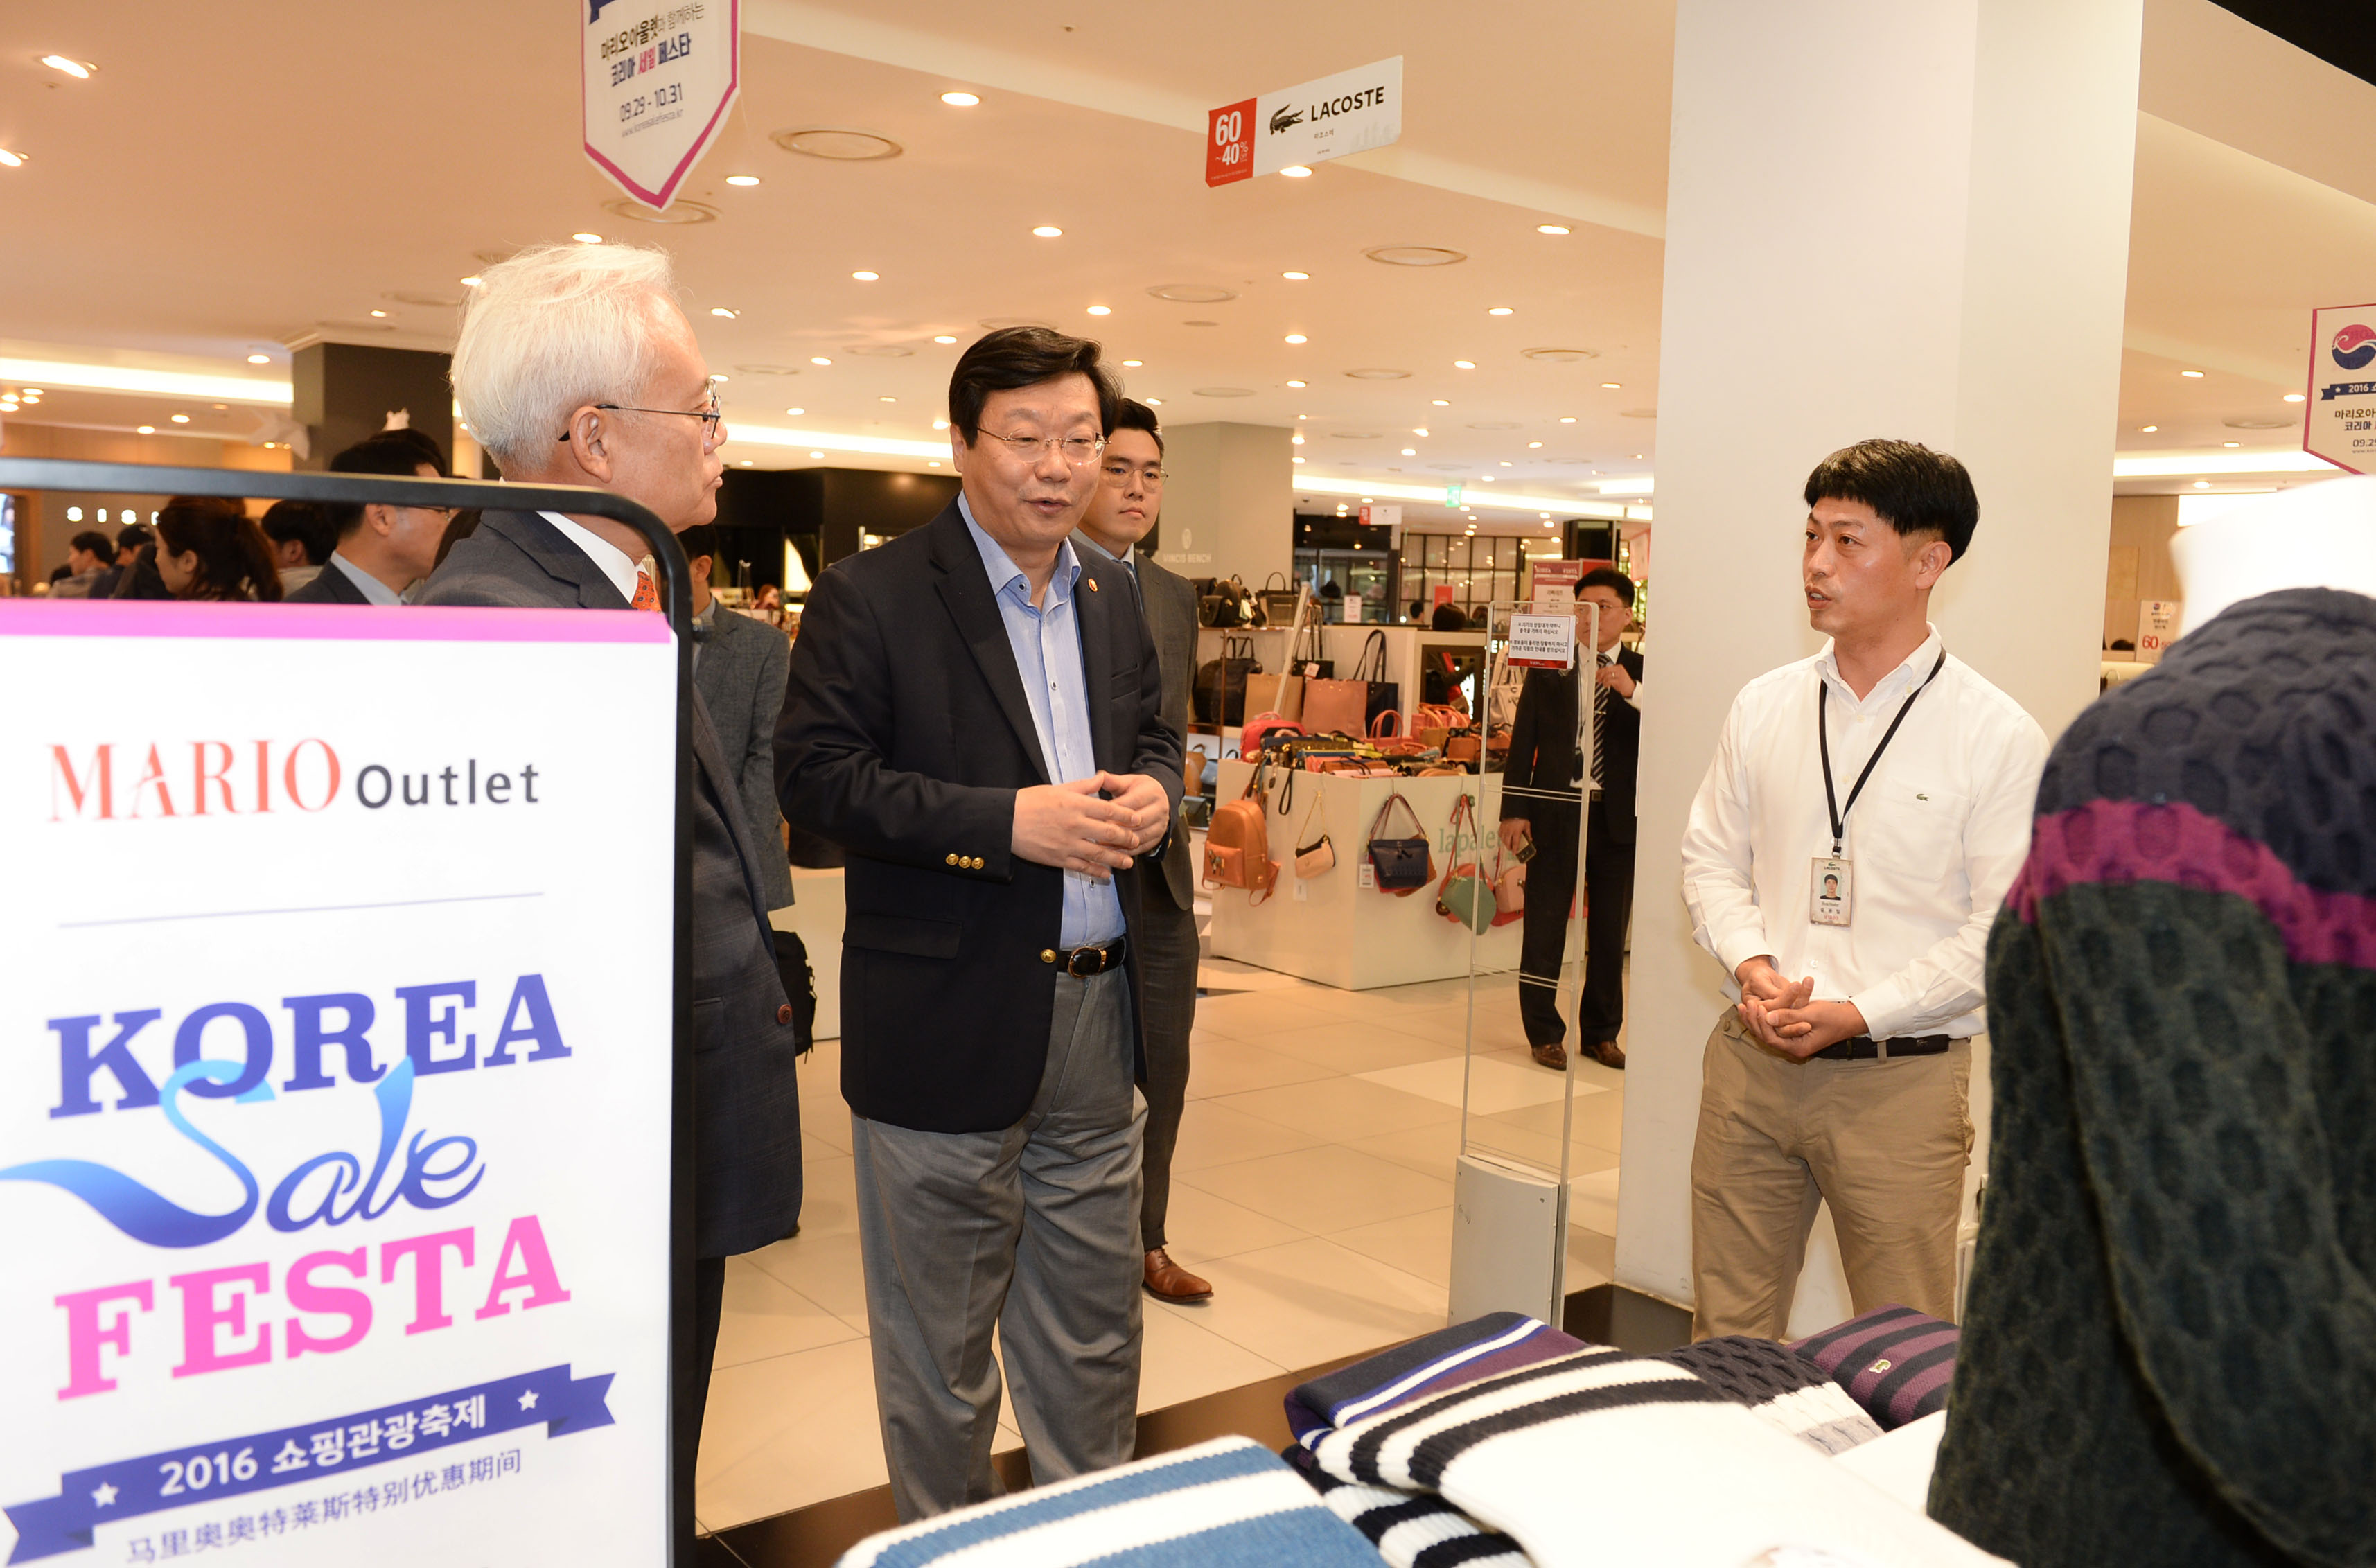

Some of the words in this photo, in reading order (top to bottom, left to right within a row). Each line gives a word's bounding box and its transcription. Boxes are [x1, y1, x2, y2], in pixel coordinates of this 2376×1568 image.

[611, 55, 635, 87] 코리아
[637, 46, 656, 75] 세일
[658, 32, 692, 65] 페스타
[620, 96, 645, 122] 09.29
[654, 82, 683, 108] 10.31
[1311, 86, 1384, 123] LACOSTE
[1215, 111, 1242, 146] 60
[2348, 383, 2369, 393] 2016
[2344, 421, 2372, 431] 코리아
[2142, 635, 2158, 649] 60
[46, 737, 341, 824] MARIO
[356, 758, 539, 809] Outlet
[47, 973, 571, 1120] KOREA
[0, 1054, 485, 1249] Sale
[54, 1213, 570, 1401] FESTA
[158, 1447, 258, 1497] 2016
[271, 1393, 486, 1474] 쇼핑관광축제
